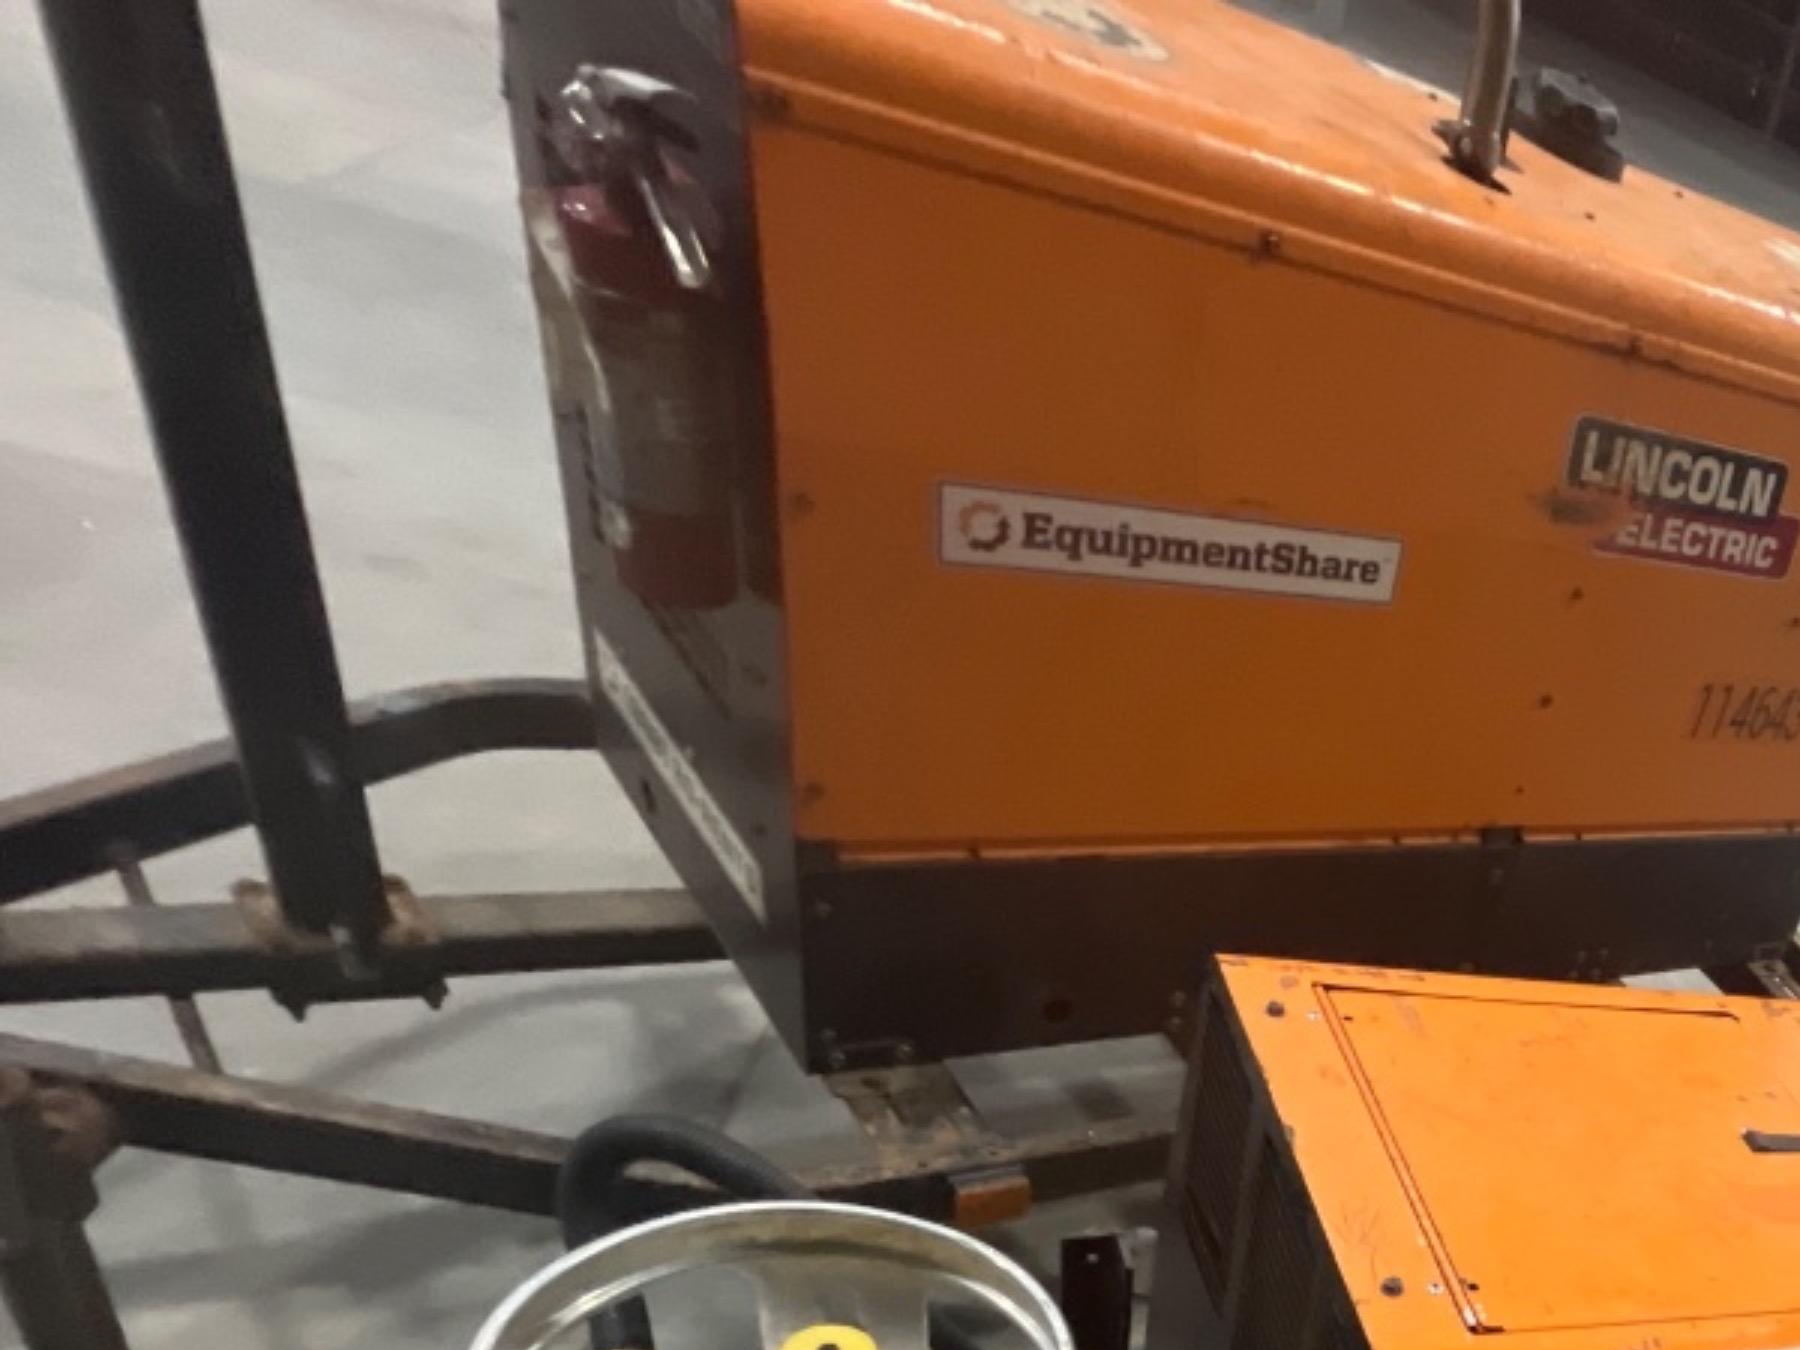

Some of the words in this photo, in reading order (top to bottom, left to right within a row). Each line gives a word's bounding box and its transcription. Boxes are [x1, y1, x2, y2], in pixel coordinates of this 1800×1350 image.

[1581, 430, 1777, 518] LINCOLN
[1019, 511, 1382, 585] EquipmentShare
[1617, 512, 1779, 569] ELECTRIC
